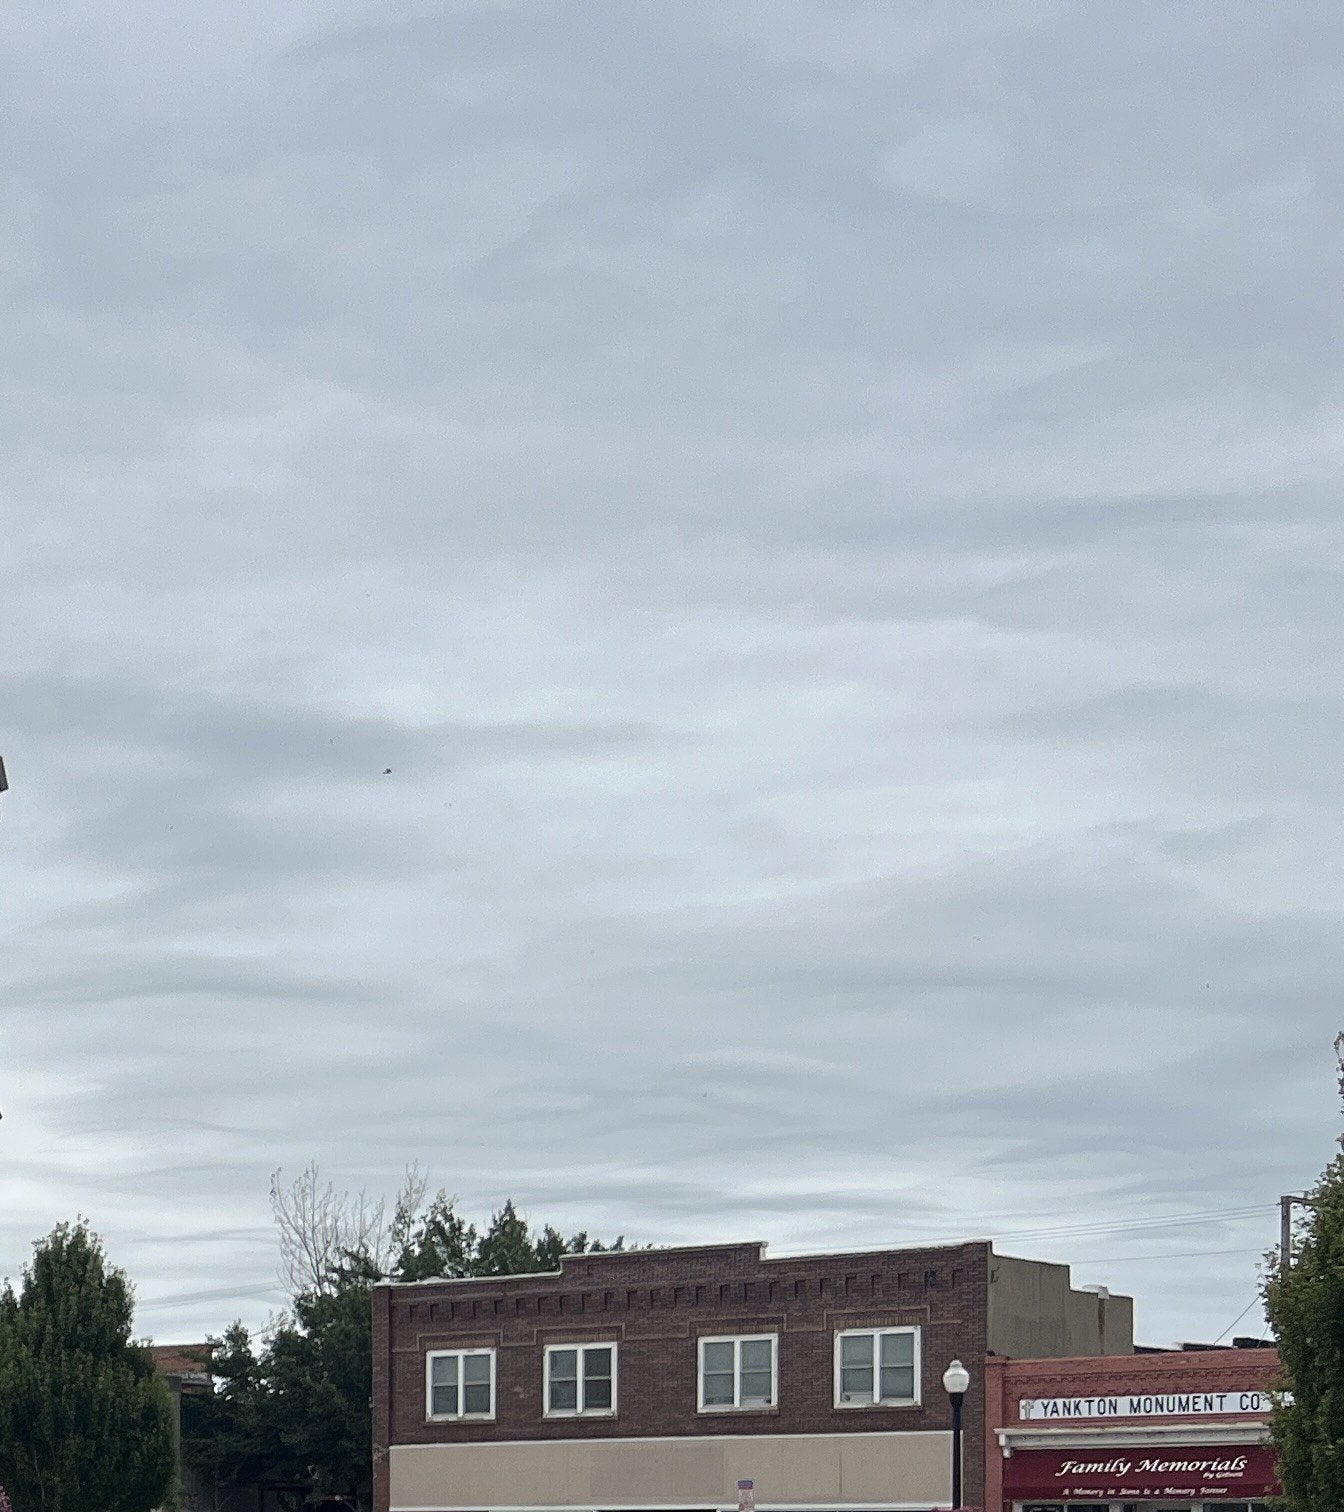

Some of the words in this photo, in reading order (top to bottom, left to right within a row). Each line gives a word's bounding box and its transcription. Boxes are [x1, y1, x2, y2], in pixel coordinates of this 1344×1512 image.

[1042, 1399, 1118, 1418] YANKTON
[1130, 1395, 1228, 1414] MONUMENT
[1055, 1458, 1132, 1478] Family
[1135, 1456, 1248, 1473] Memorials
